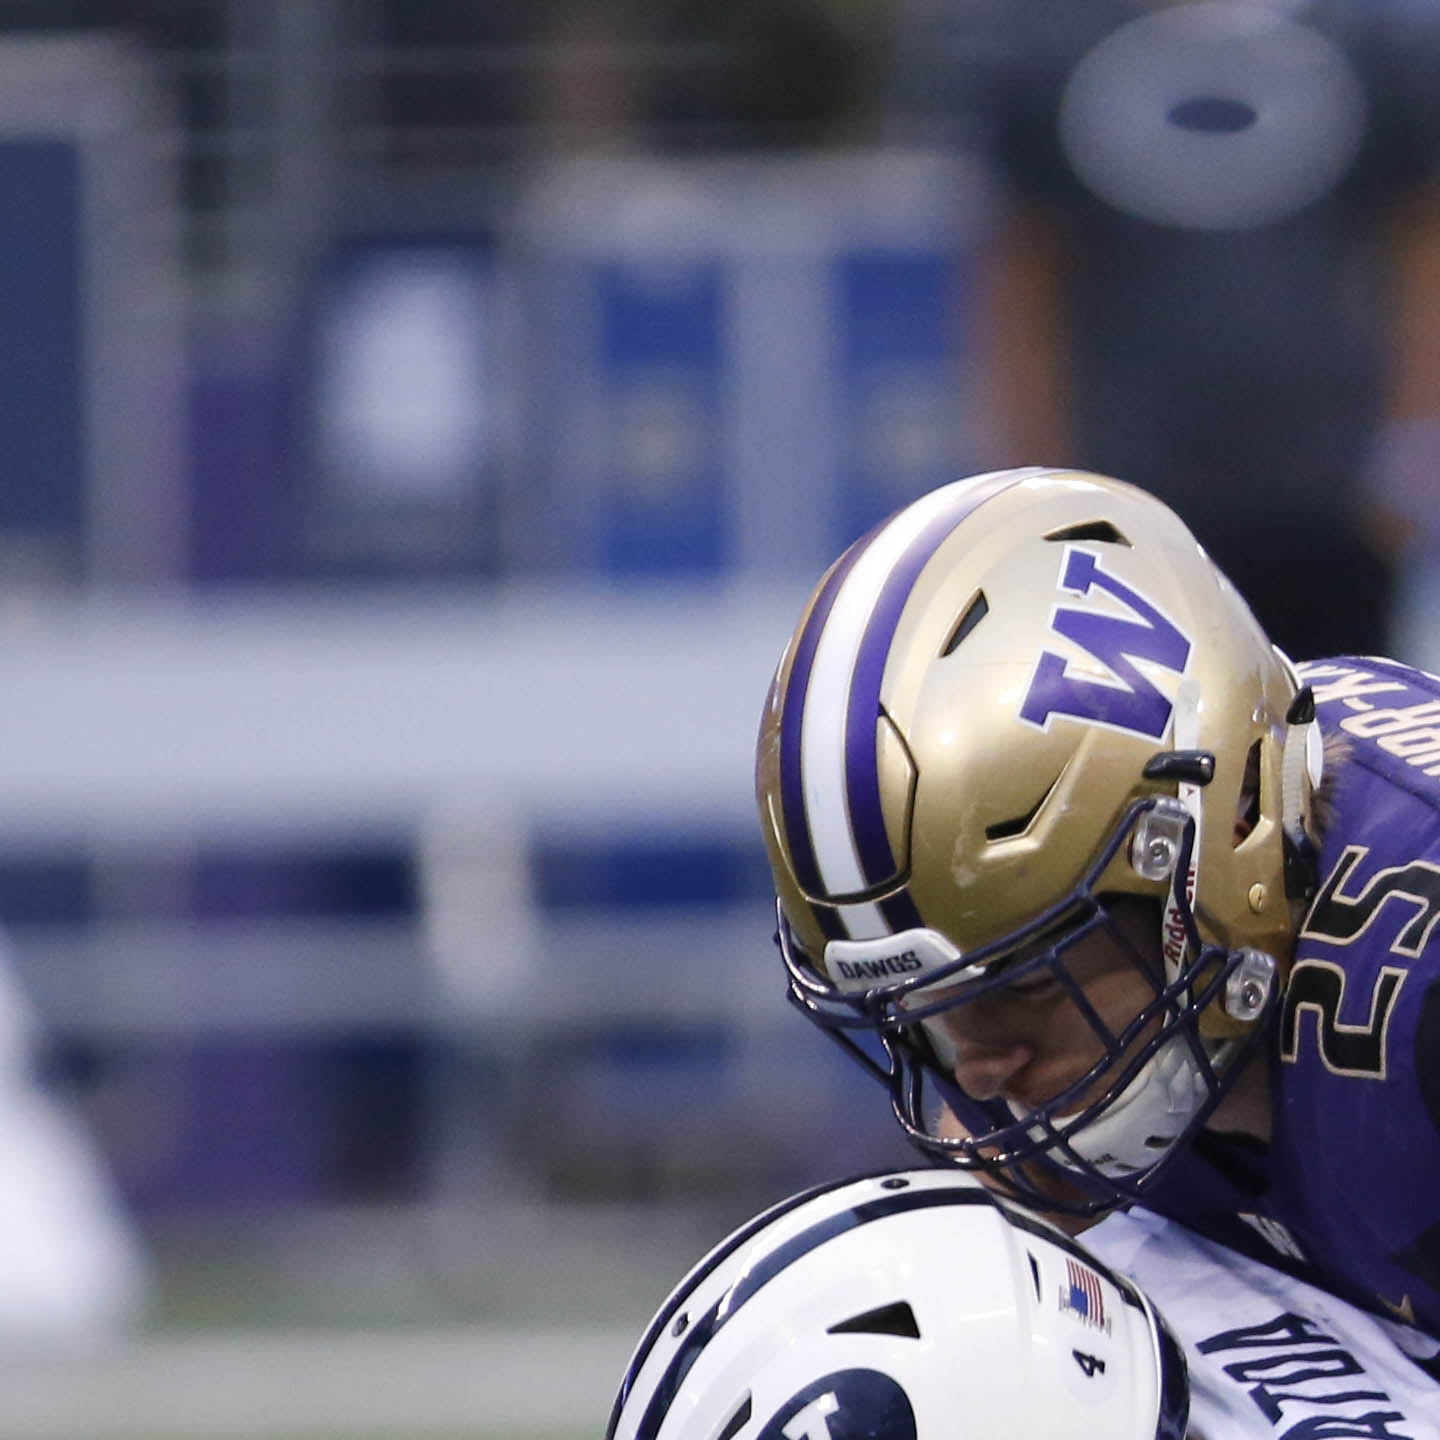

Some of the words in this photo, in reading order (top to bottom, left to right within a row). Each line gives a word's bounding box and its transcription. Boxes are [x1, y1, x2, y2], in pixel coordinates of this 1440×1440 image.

[1017, 546, 1194, 742] W
[837, 951, 922, 978] DAWGS
[1072, 1348, 1105, 1377] 4
